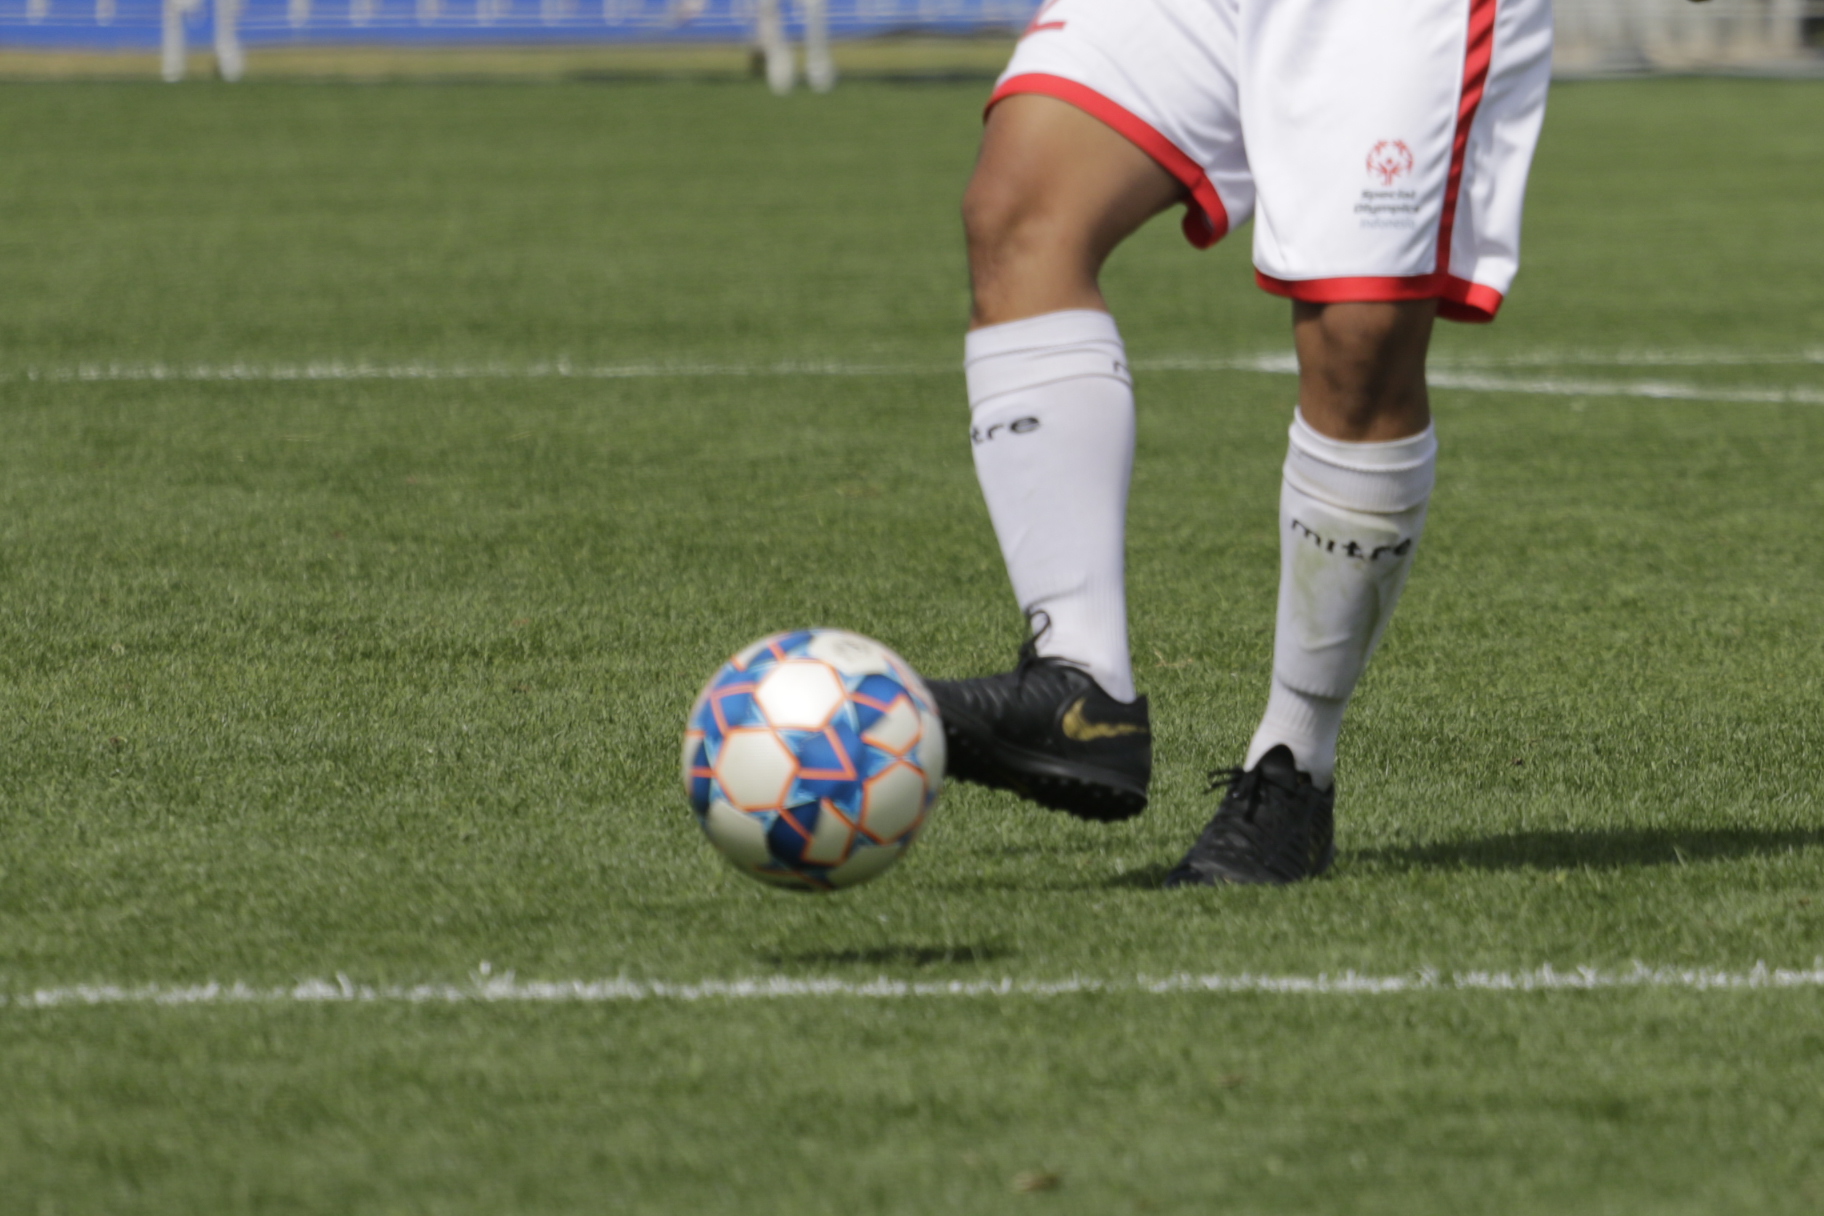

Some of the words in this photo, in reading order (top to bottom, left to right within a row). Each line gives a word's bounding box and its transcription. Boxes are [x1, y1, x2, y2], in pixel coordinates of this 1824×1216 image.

[1361, 189, 1416, 201] Special
[1354, 203, 1420, 216] Olympics
[971, 415, 1040, 445] tre
[1290, 518, 1413, 563] mitre
